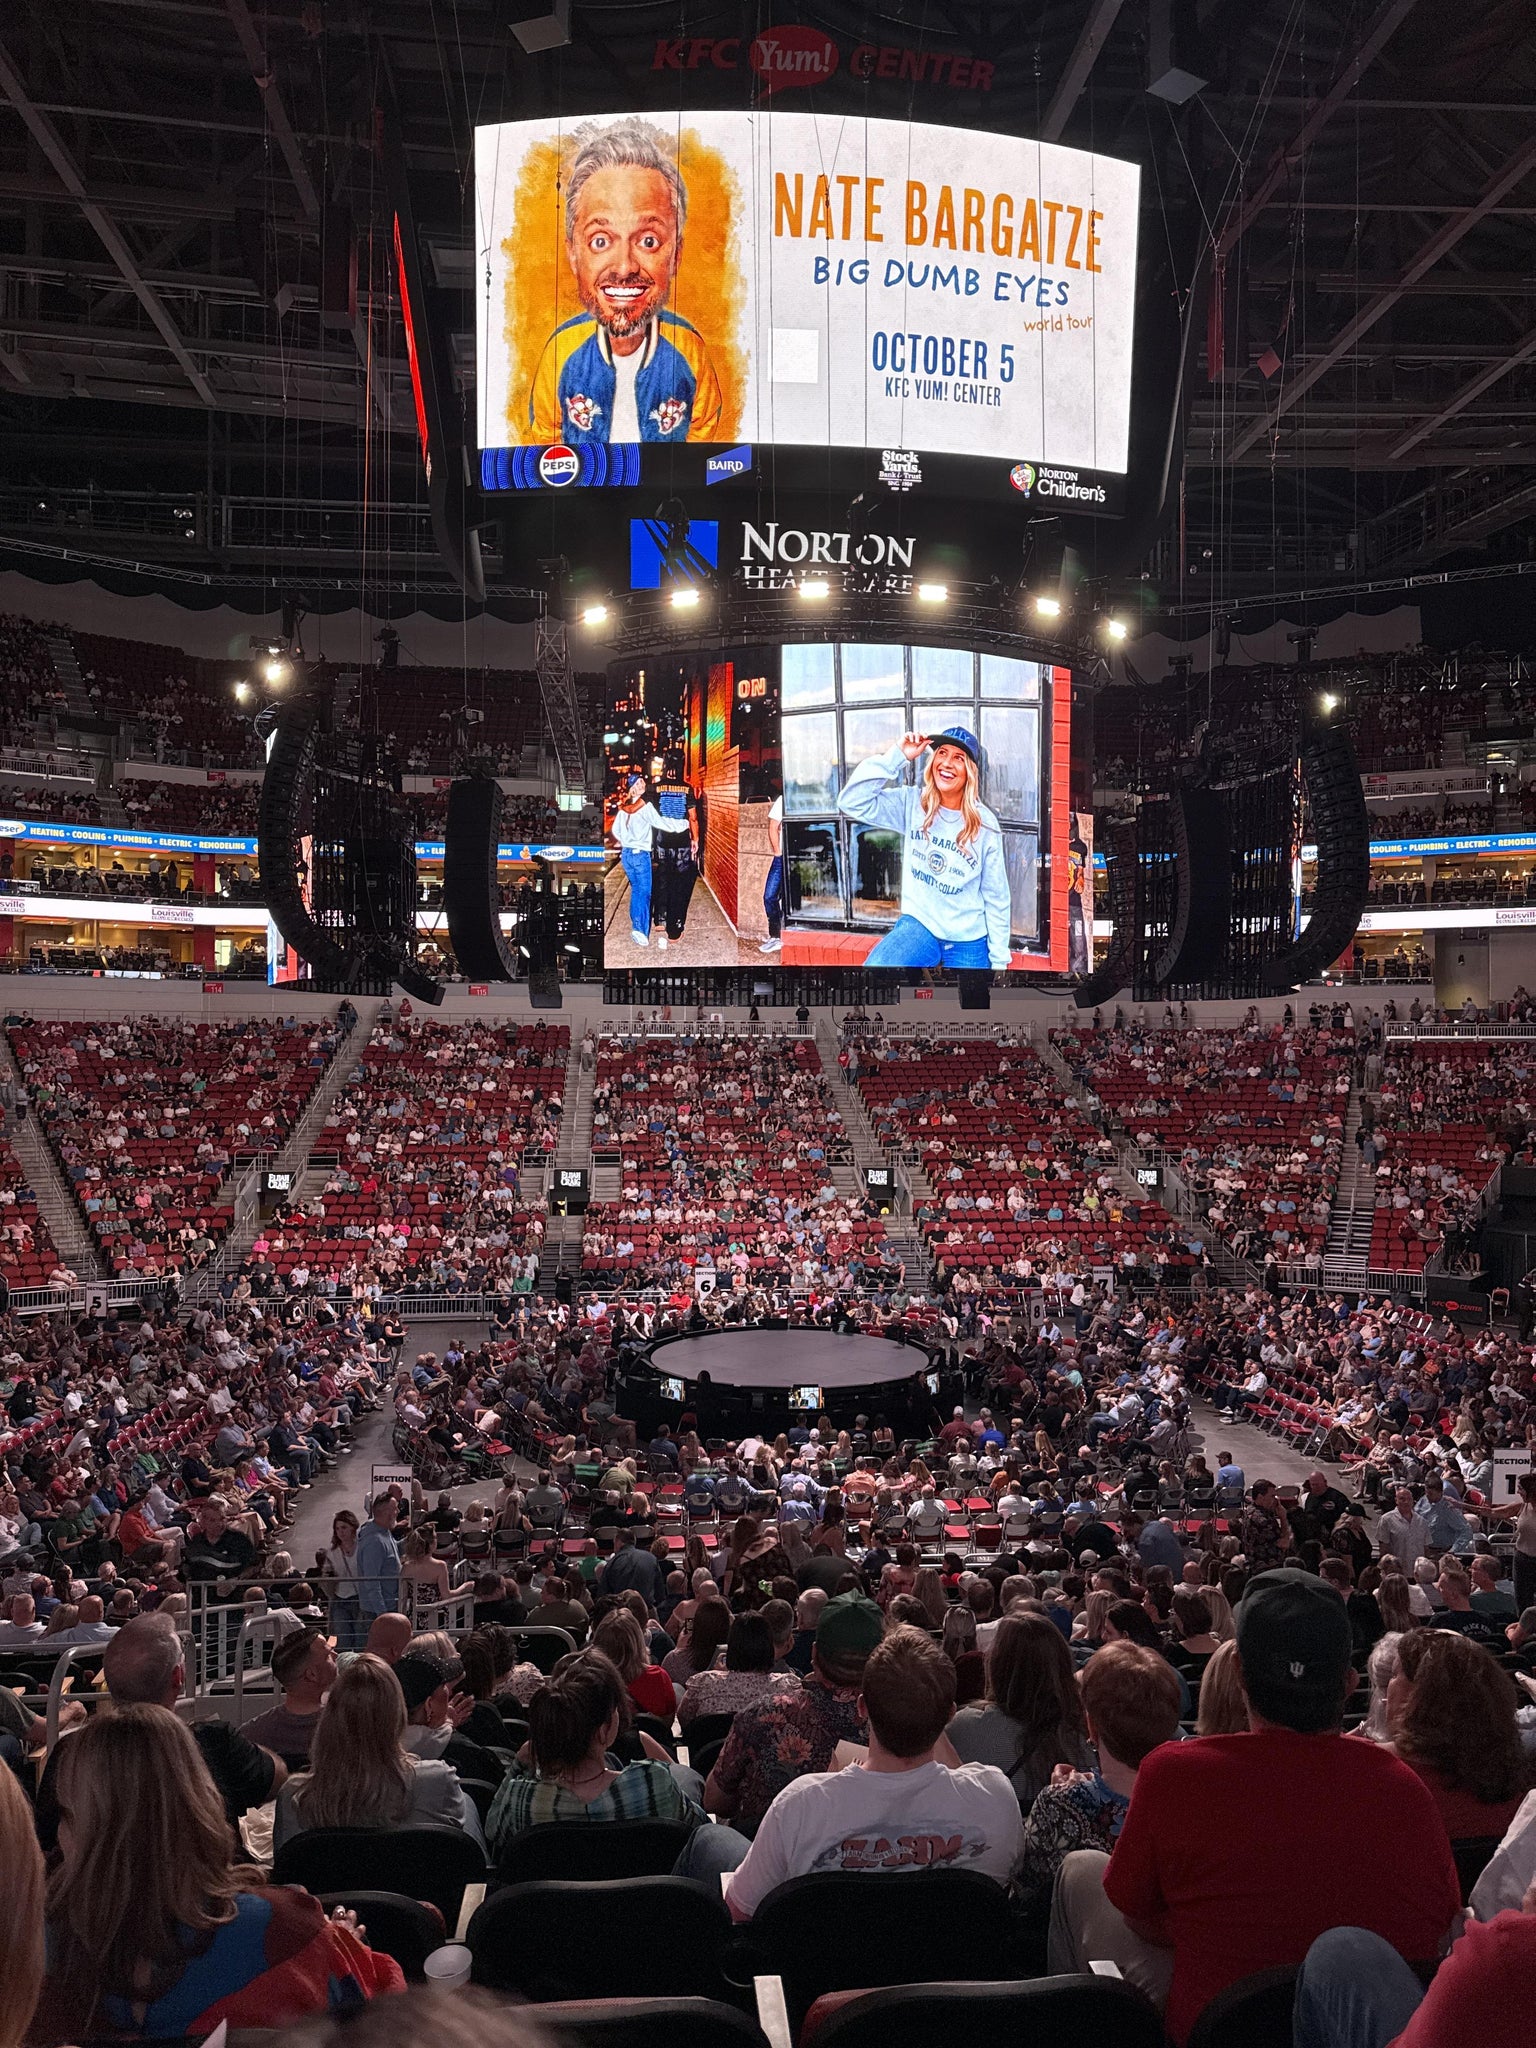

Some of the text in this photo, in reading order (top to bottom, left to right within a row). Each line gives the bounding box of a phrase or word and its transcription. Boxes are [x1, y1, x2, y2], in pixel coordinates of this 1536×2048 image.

[650, 38, 996, 91] KFC Yum! CENTER
[774, 172, 1104, 273] NATE BARGATZE
[813, 256, 1070, 307] BIG DUMB EYES
[1023, 313, 1093, 332] world tour
[872, 331, 1015, 383] OCTOBER 5
[885, 377, 1002, 407] KFC YUM! CENTER
[882, 450, 919, 463] Stock
[542, 460, 576, 471] PEPSI
[708, 460, 743, 472] BAIRD
[882, 460, 922, 473] Yards.
[1038, 467, 1079, 481] NORTON
[1037, 478, 1106, 503] Children's
[738, 677, 766, 698] ON
[30, 826, 65, 838] HEATING
[72, 830, 107, 841] COOLING
[113, 834, 152, 845] PLUMBING
[159, 838, 192, 848] ELECTRIC
[199, 841, 246, 850] REMODELING
[1369, 845, 1402, 853] COOLING
[1409, 842, 1449, 852] PLUMBING
[1456, 839, 1491, 849] ELECTRIC
[537, 849, 570, 858] maeser
[152, 908, 194, 917] Louisville
[700, 1280, 711, 1293] 6
[1098, 1279, 1109, 1290] 7
[93, 1296, 102, 1309] 5
[1034, 1305, 1041, 1319] 8
[373, 1475, 411, 1483] SECTION
